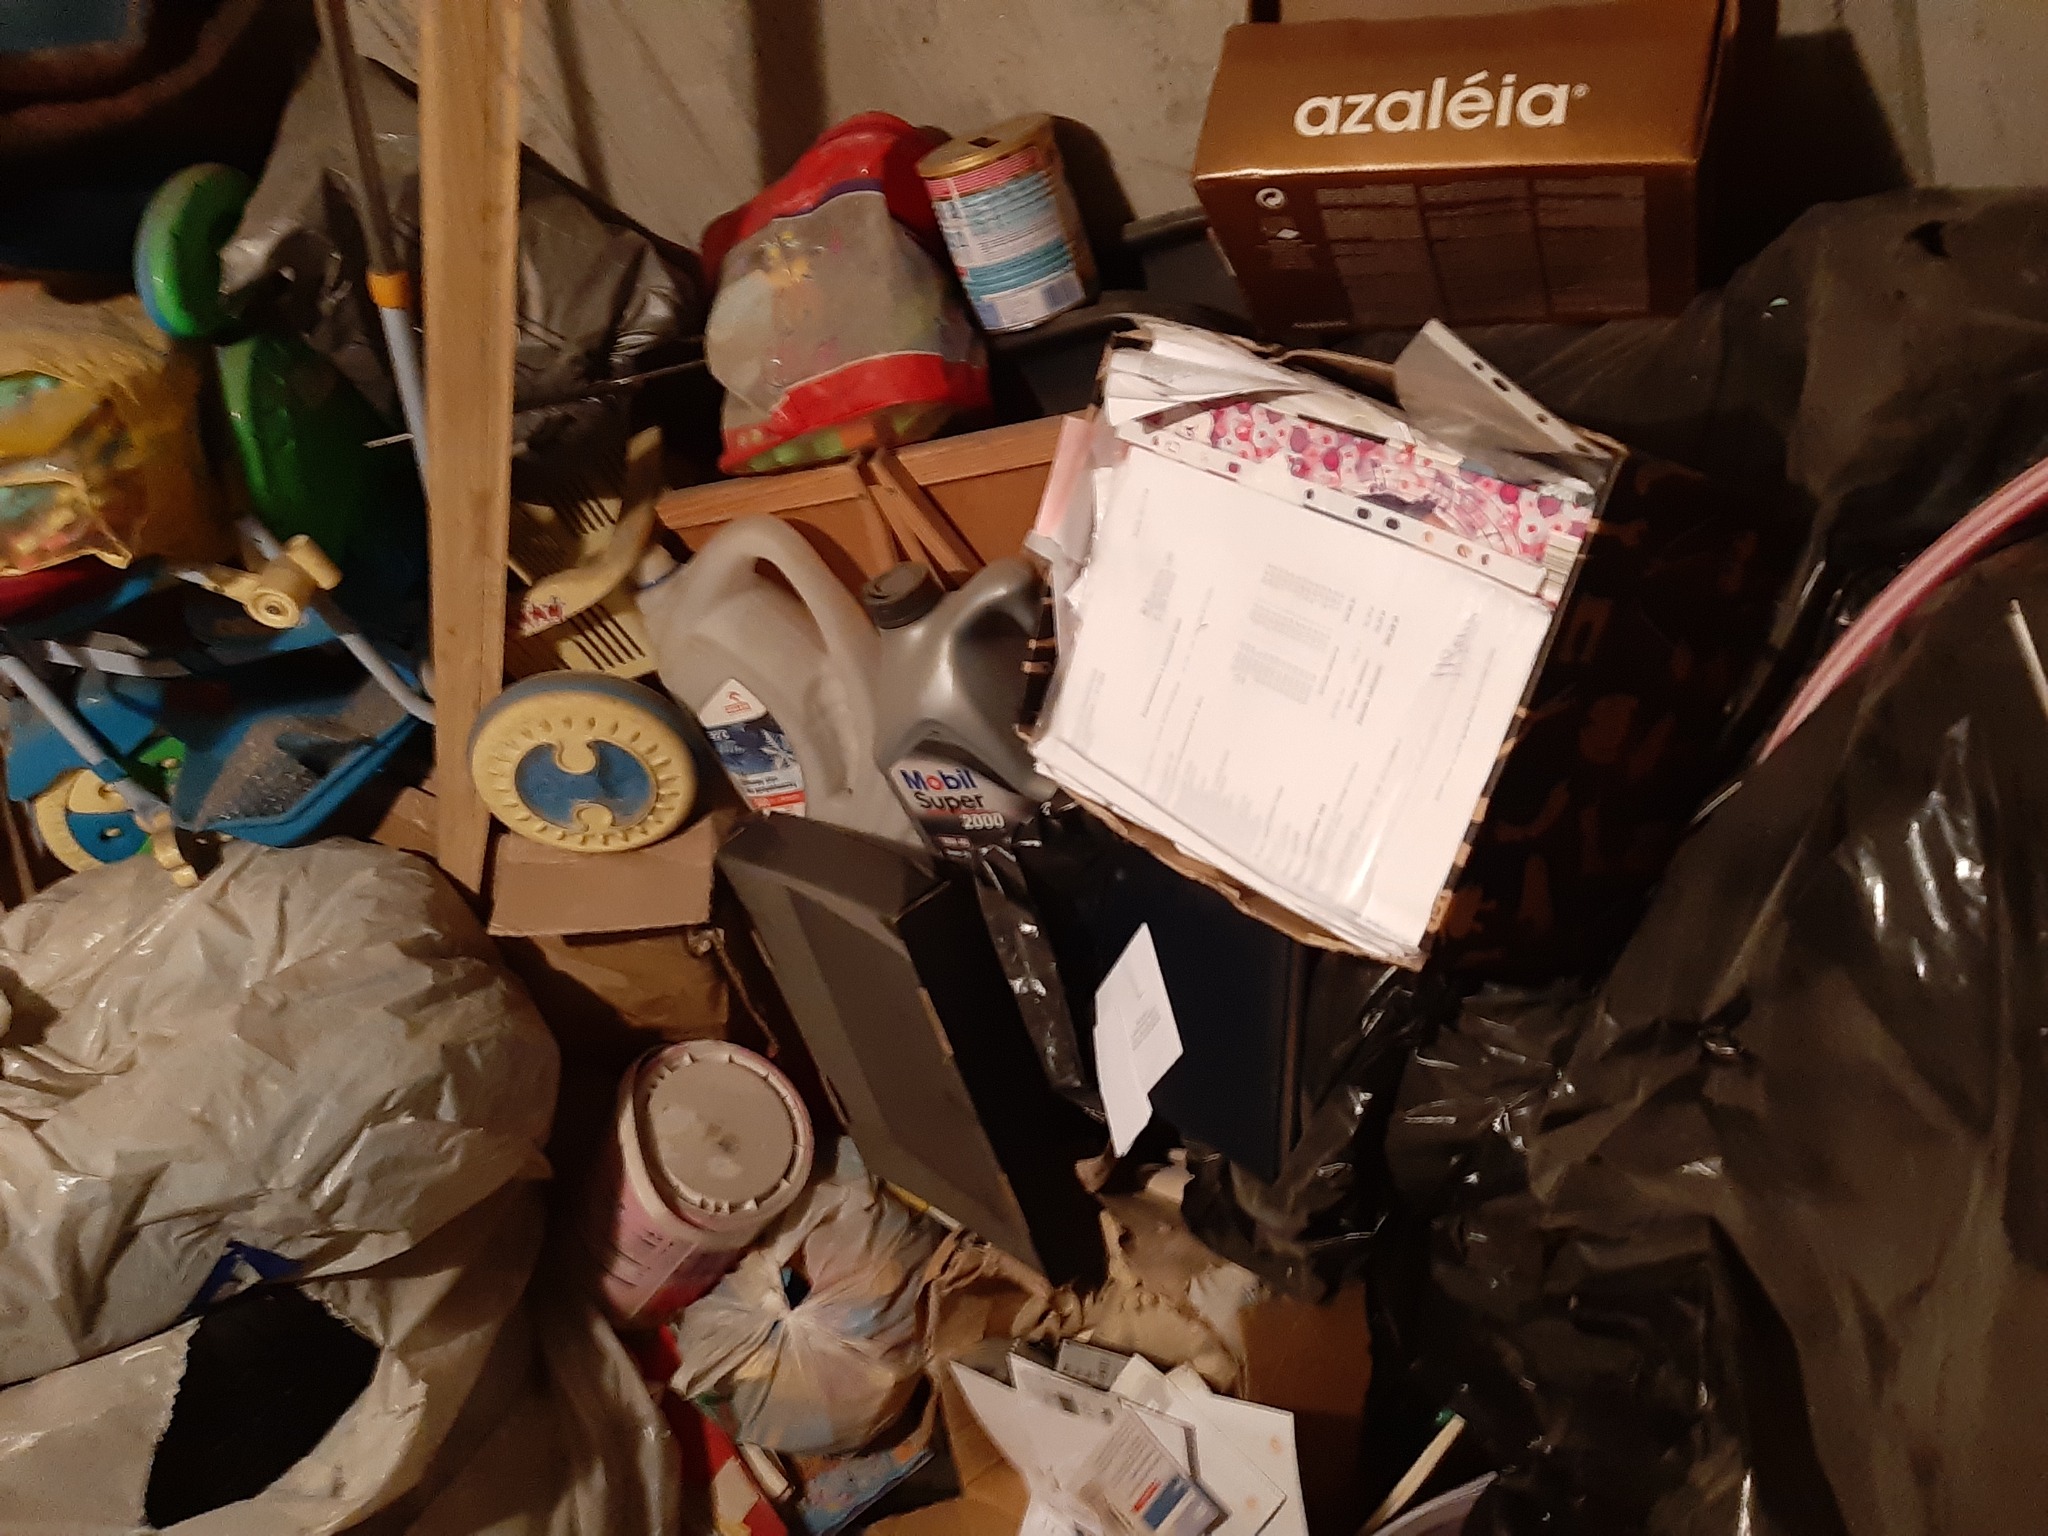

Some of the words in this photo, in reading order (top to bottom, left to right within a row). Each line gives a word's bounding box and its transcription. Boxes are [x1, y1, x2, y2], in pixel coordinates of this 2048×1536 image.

[1293, 69, 1573, 138] azaléia
[900, 769, 977, 790] Mobil
[914, 791, 984, 813] Super
[961, 813, 1005, 830] 2000
